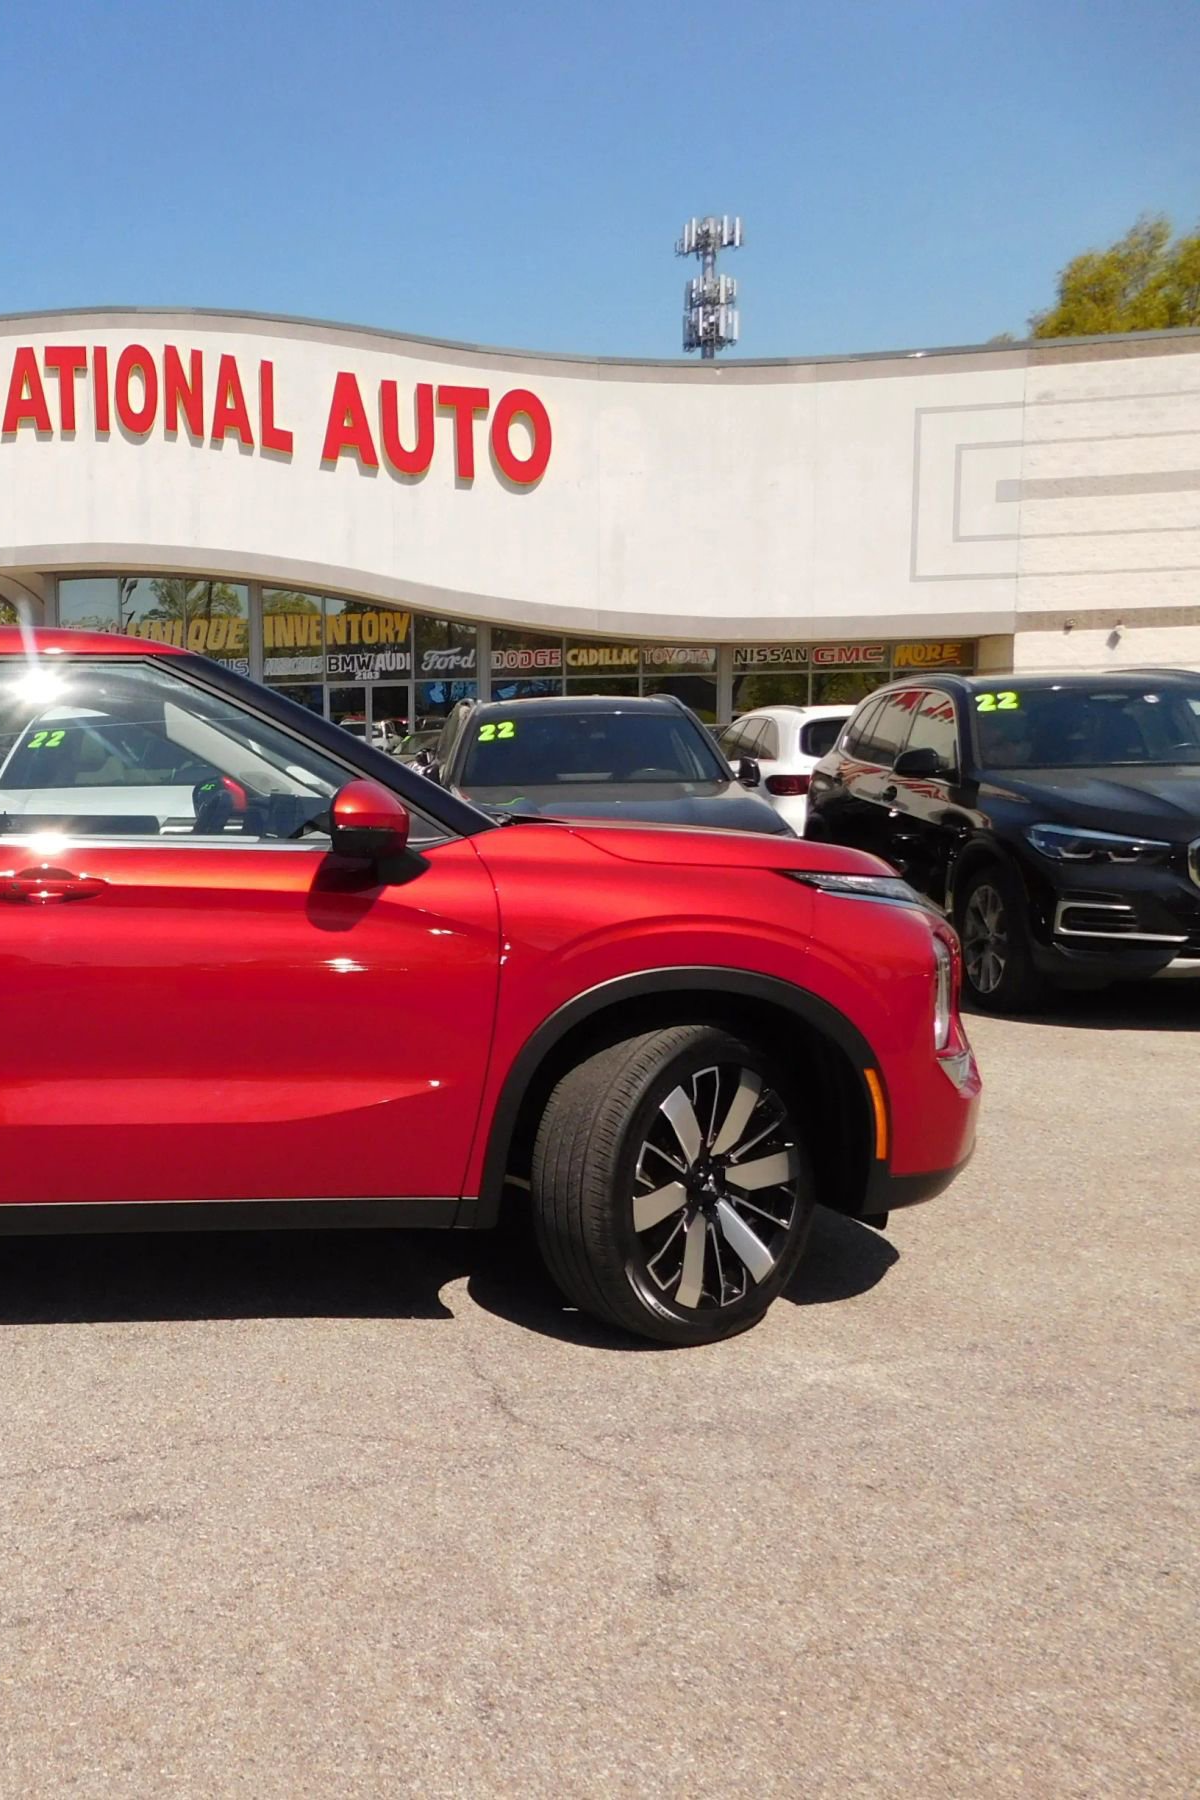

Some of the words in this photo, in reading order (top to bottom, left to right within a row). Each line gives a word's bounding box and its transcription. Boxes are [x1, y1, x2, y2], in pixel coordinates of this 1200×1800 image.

[321, 371, 552, 485] AUTO
[263, 611, 410, 648] INVENTORY
[327, 654, 374, 674] BMW
[374, 652, 411, 672] AUDI
[421, 647, 476, 671] Ford
[491, 648, 562, 669] DODGE
[566, 648, 639, 666] CADILLAC
[644, 647, 715, 665] TOYOTA
[733, 647, 808, 665] NISSAN
[812, 645, 885, 665] GMC
[894, 643, 961, 667] MORE
[975, 692, 1019, 712] 22
[27, 730, 65, 748] 22
[478, 721, 515, 741] 22
